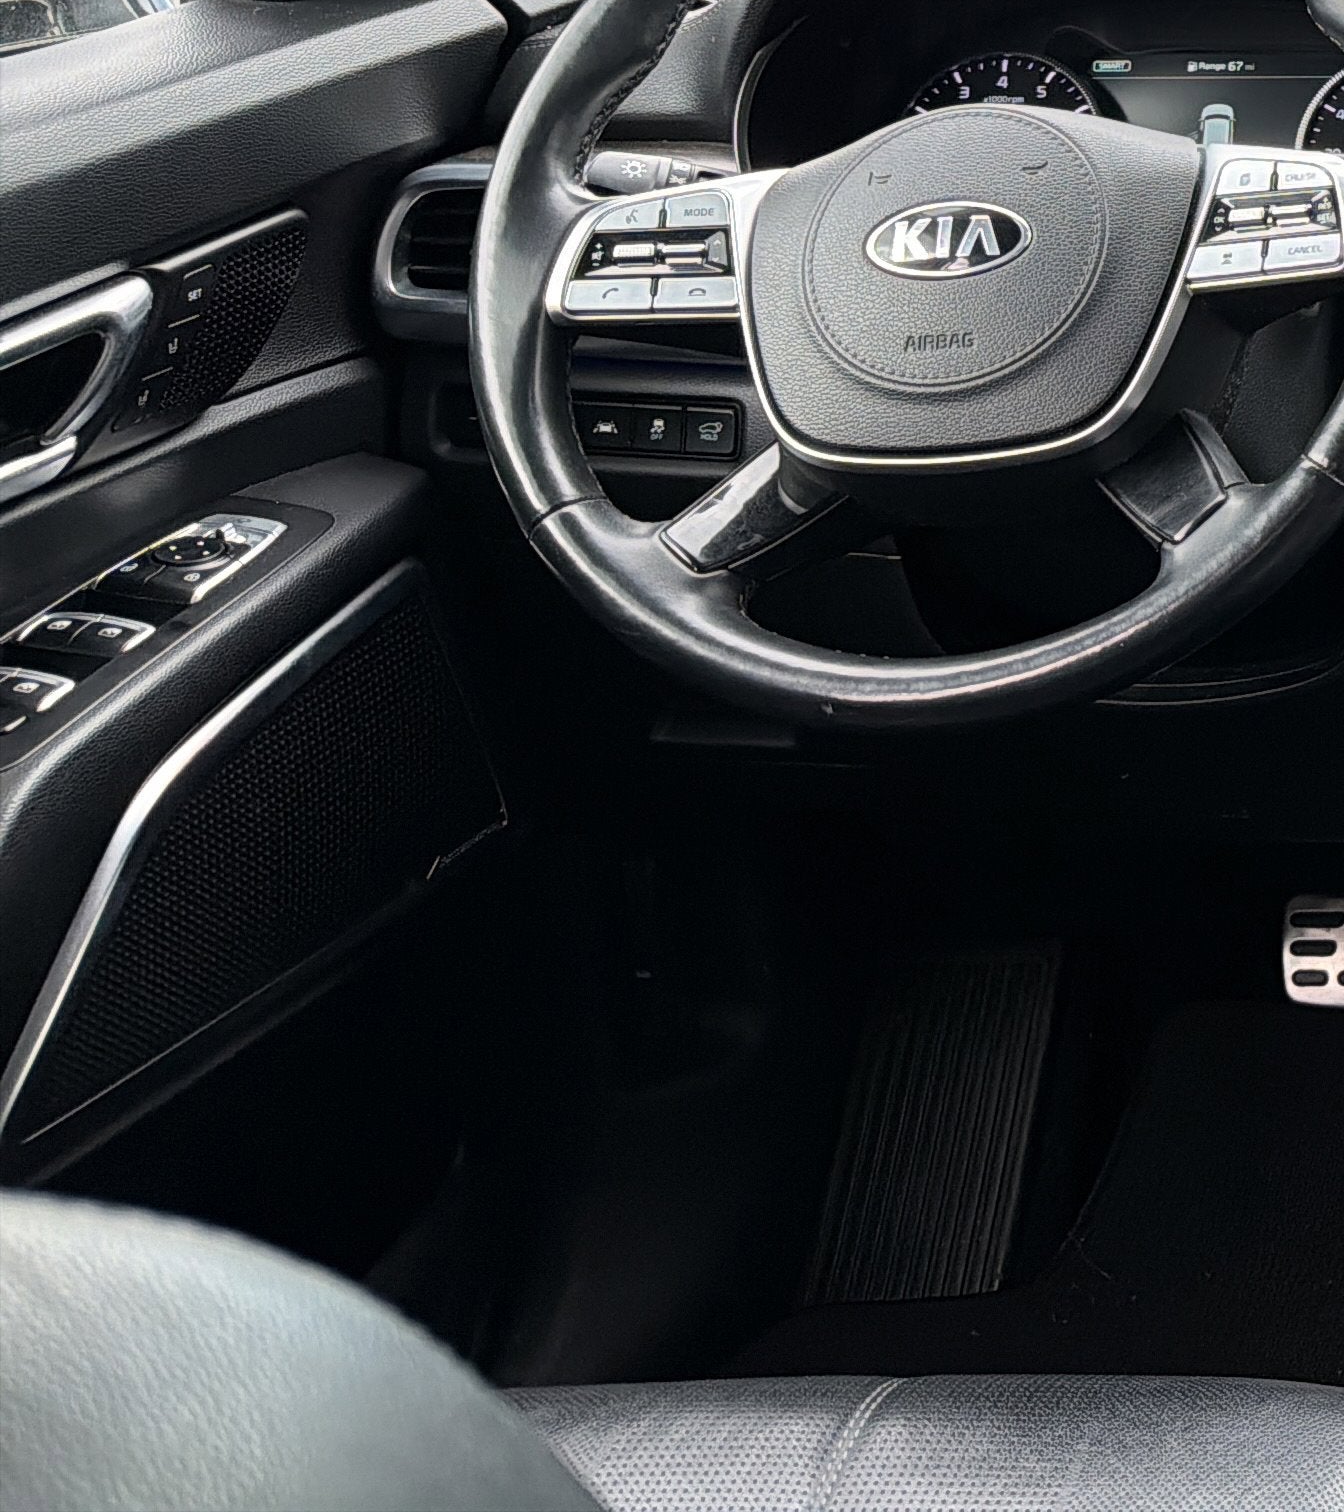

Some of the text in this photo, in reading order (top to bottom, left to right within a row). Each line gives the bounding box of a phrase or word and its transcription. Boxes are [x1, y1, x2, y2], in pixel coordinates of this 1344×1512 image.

[1198, 61, 1226, 71] Range
[1228, 61, 1244, 72] 67
[996, 76, 1009, 89] 4
[958, 87, 970, 99] 3
[1036, 86, 1047, 98] 5
[683, 208, 714, 217] MODE
[891, 214, 1001, 263] KIA
[1287, 245, 1322, 256] CANCEL
[903, 331, 975, 353] AIRBAG
